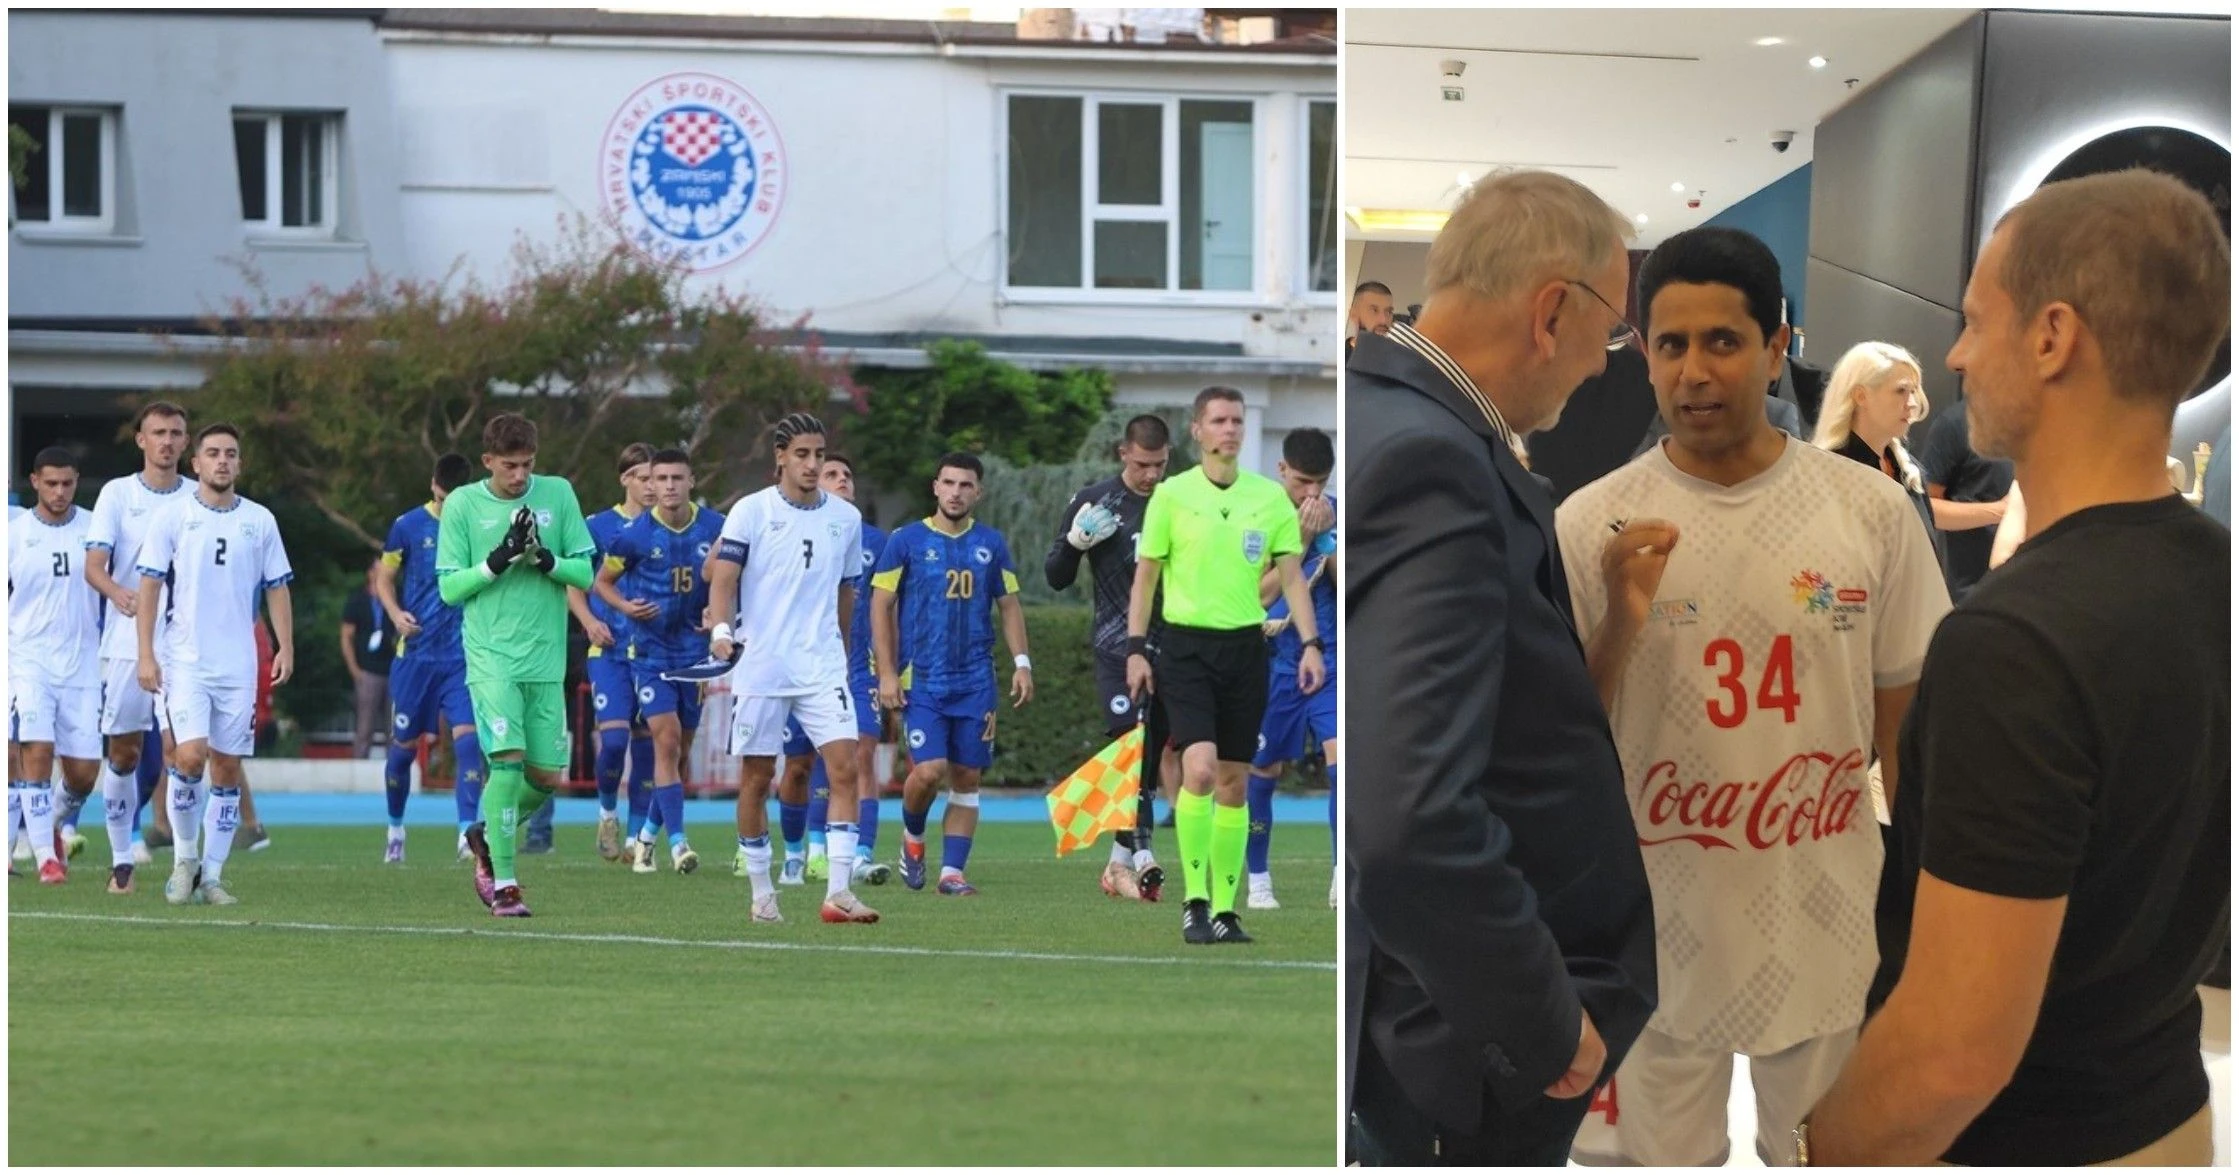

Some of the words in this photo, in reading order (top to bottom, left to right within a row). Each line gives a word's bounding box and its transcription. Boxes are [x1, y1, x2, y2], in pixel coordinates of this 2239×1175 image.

[757, 151, 776, 213] KLUB
[52, 552, 70, 577] 21
[215, 537, 227, 565] 2
[802, 539, 813, 569] 7
[671, 566, 693, 593] 15
[946, 569, 973, 599] 20
[1704, 634, 1801, 729] 34
[834, 687, 848, 711] 7
[1639, 747, 1864, 850] Coca-Cola
